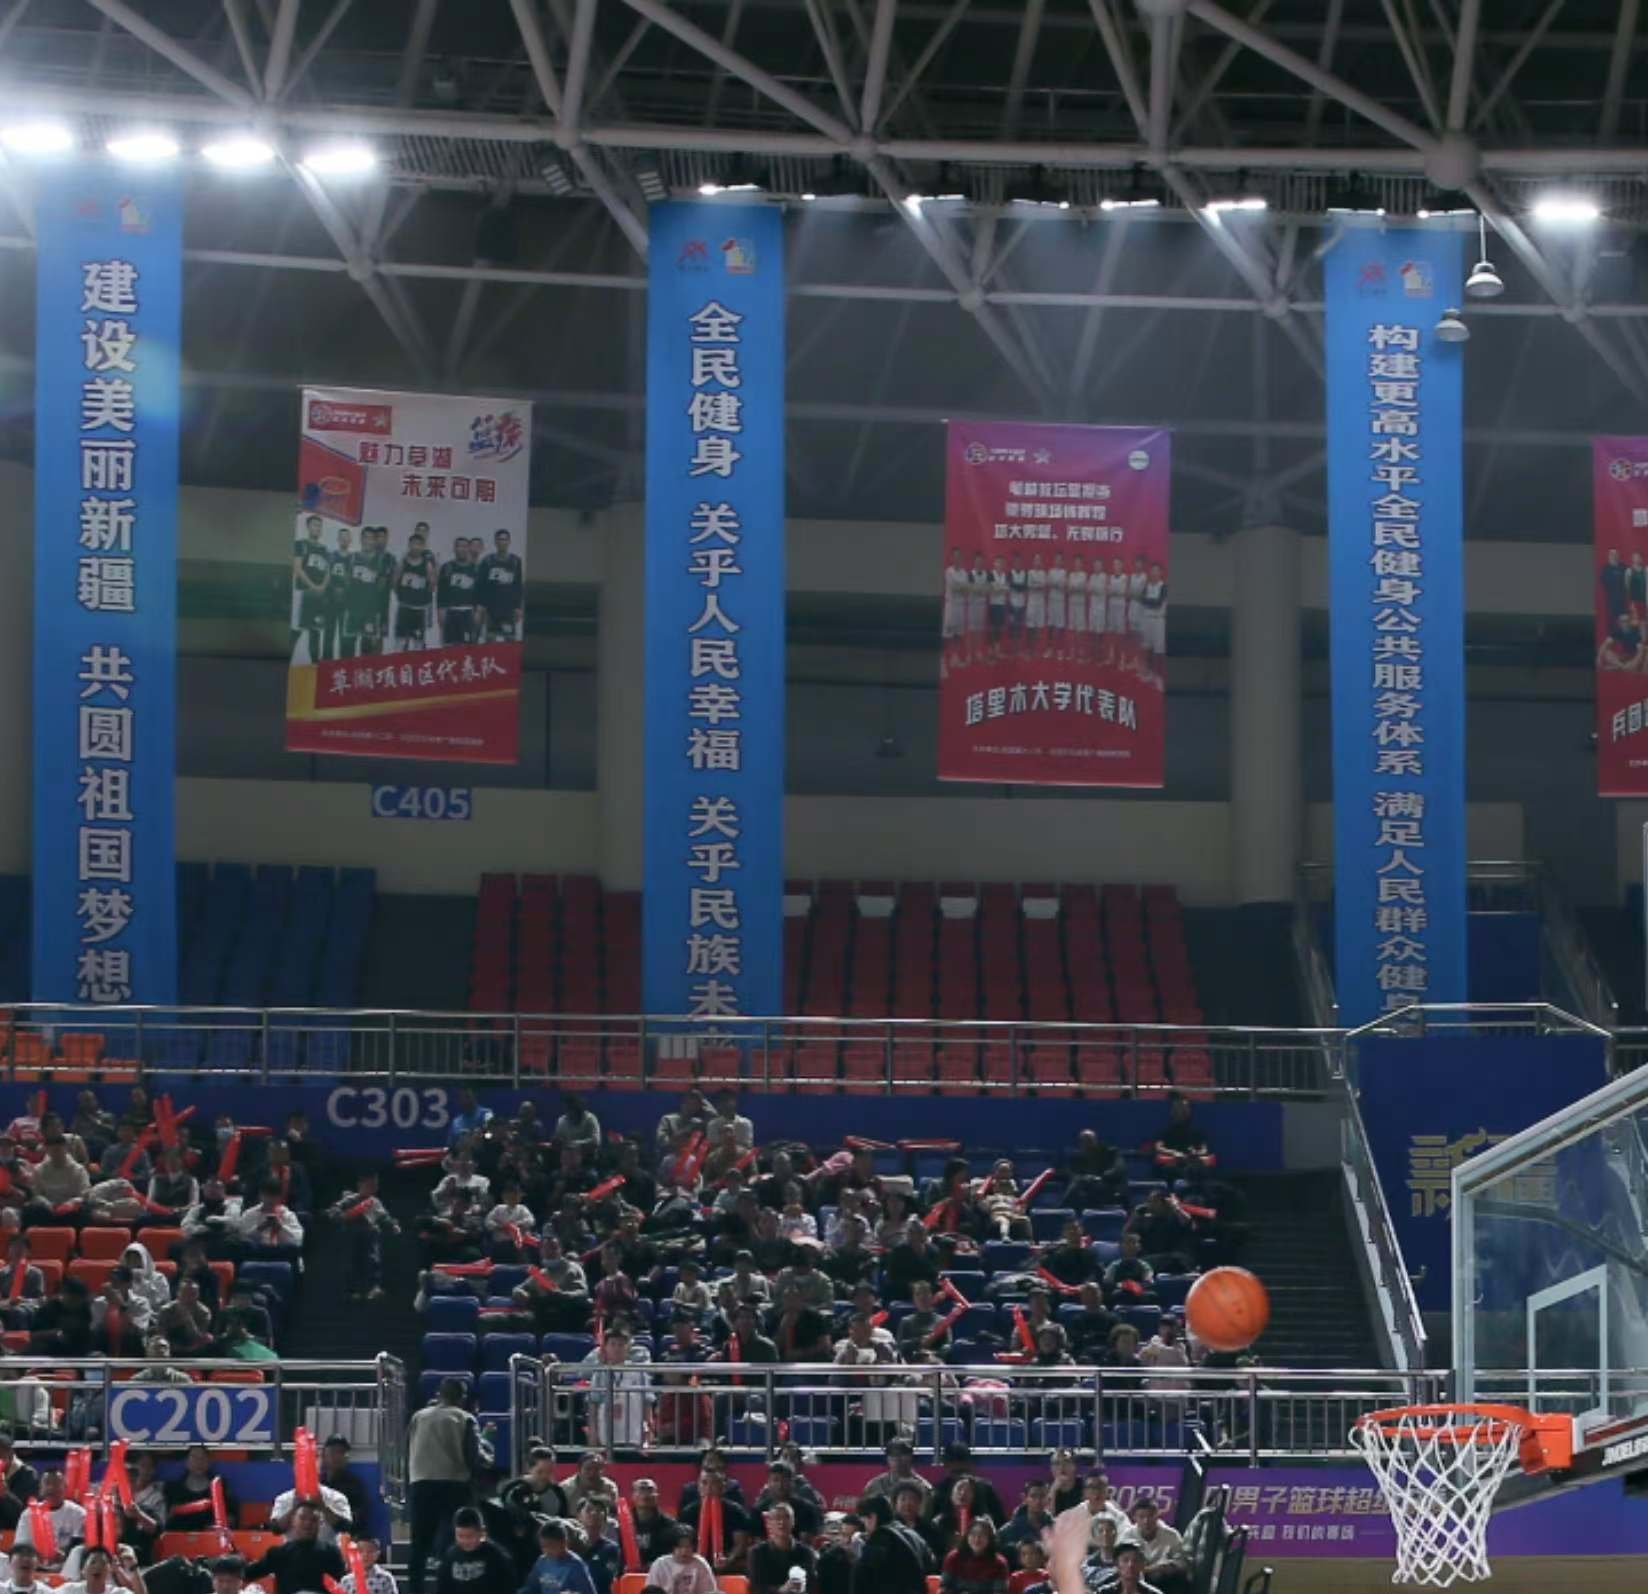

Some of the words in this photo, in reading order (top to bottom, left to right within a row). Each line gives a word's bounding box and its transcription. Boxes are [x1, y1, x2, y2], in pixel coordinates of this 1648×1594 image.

[77, 259, 140, 614] 建设美丽新疆
[687, 300, 743, 479] 全民健身
[686, 501, 742, 772] 关乎人民幸福
[1368, 324, 1425, 777] 构建更高水平全民健身公共服务体系
[75, 645, 136, 1002] 共圆祖国梦想
[373, 786, 471, 818] C405
[326, 1086, 450, 1130] C303
[109, 1390, 273, 1443] C202
